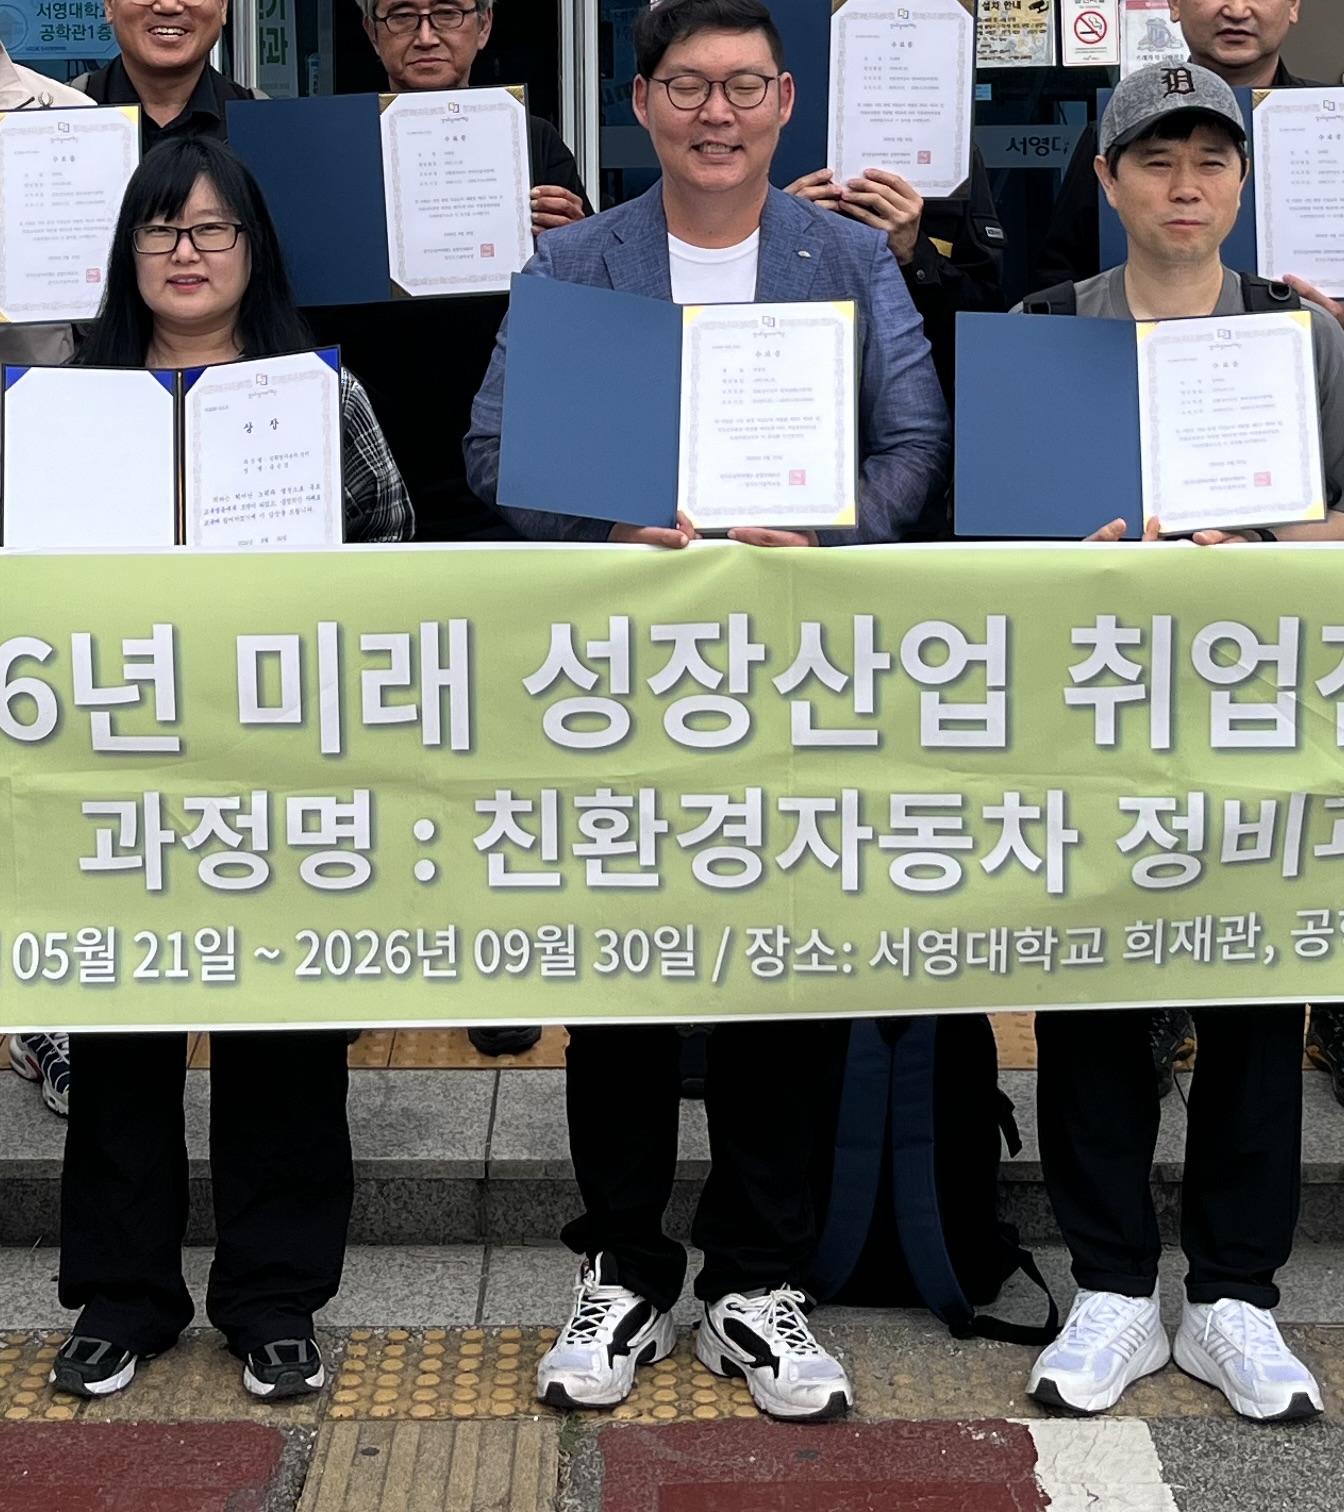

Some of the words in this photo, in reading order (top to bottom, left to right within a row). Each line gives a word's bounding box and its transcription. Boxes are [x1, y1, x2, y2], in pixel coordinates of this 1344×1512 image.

[1003, 0, 1022, 11] 안내
[236, 618, 471, 755] 미래
[522, 613, 1007, 749] 성장산업
[77, 789, 375, 890] 과정명
[472, 786, 1079, 894] 친환경자동차
[11, 925, 117, 984] 05월
[132, 925, 239, 982] 21일
[294, 926, 457, 978] 2026년
[472, 923, 578, 977] 09월
[591, 923, 697, 978] 30일
[744, 925, 854, 978] 장소:
[869, 925, 1104, 978] 서영대학교
[1122, 910, 1276, 965] 희재관,
